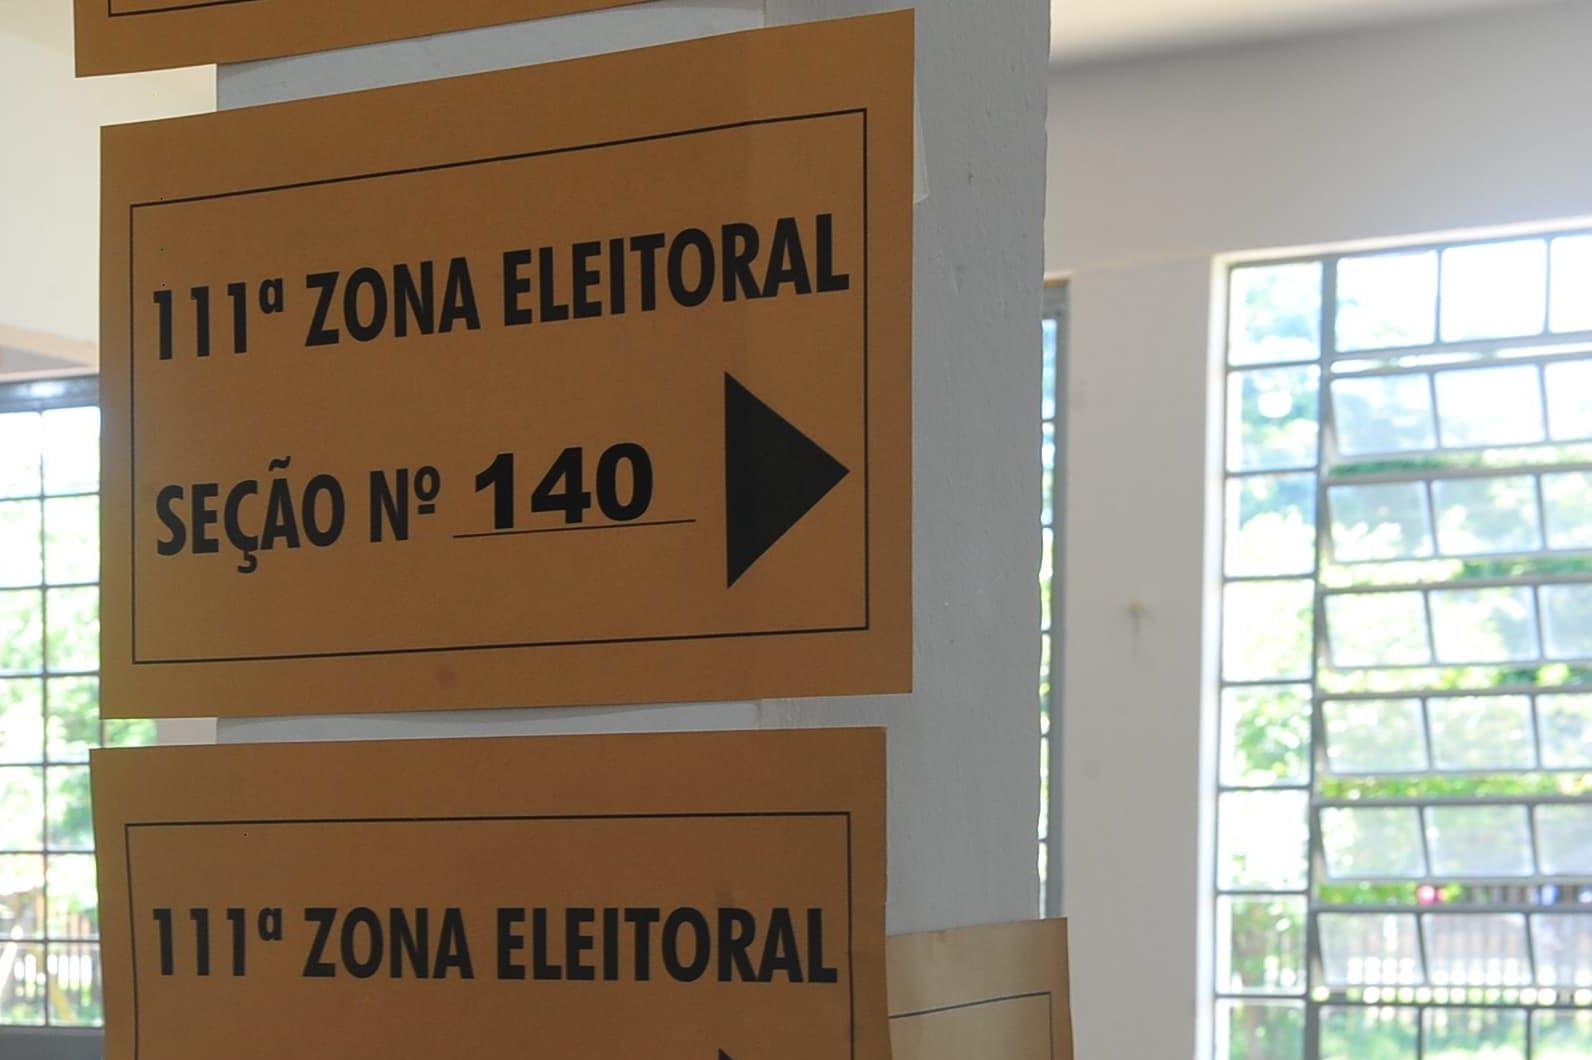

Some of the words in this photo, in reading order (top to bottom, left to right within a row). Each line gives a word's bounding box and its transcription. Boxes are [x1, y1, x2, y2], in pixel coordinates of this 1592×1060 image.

[303, 255, 482, 348] ZONA
[501, 212, 851, 328] ELEITORAL
[155, 454, 347, 575] SEÇÃO
[368, 464, 442, 544] Nº
[473, 441, 655, 531] 140
[301, 905, 476, 981] ZONA
[495, 905, 840, 985] ELEITORAL
